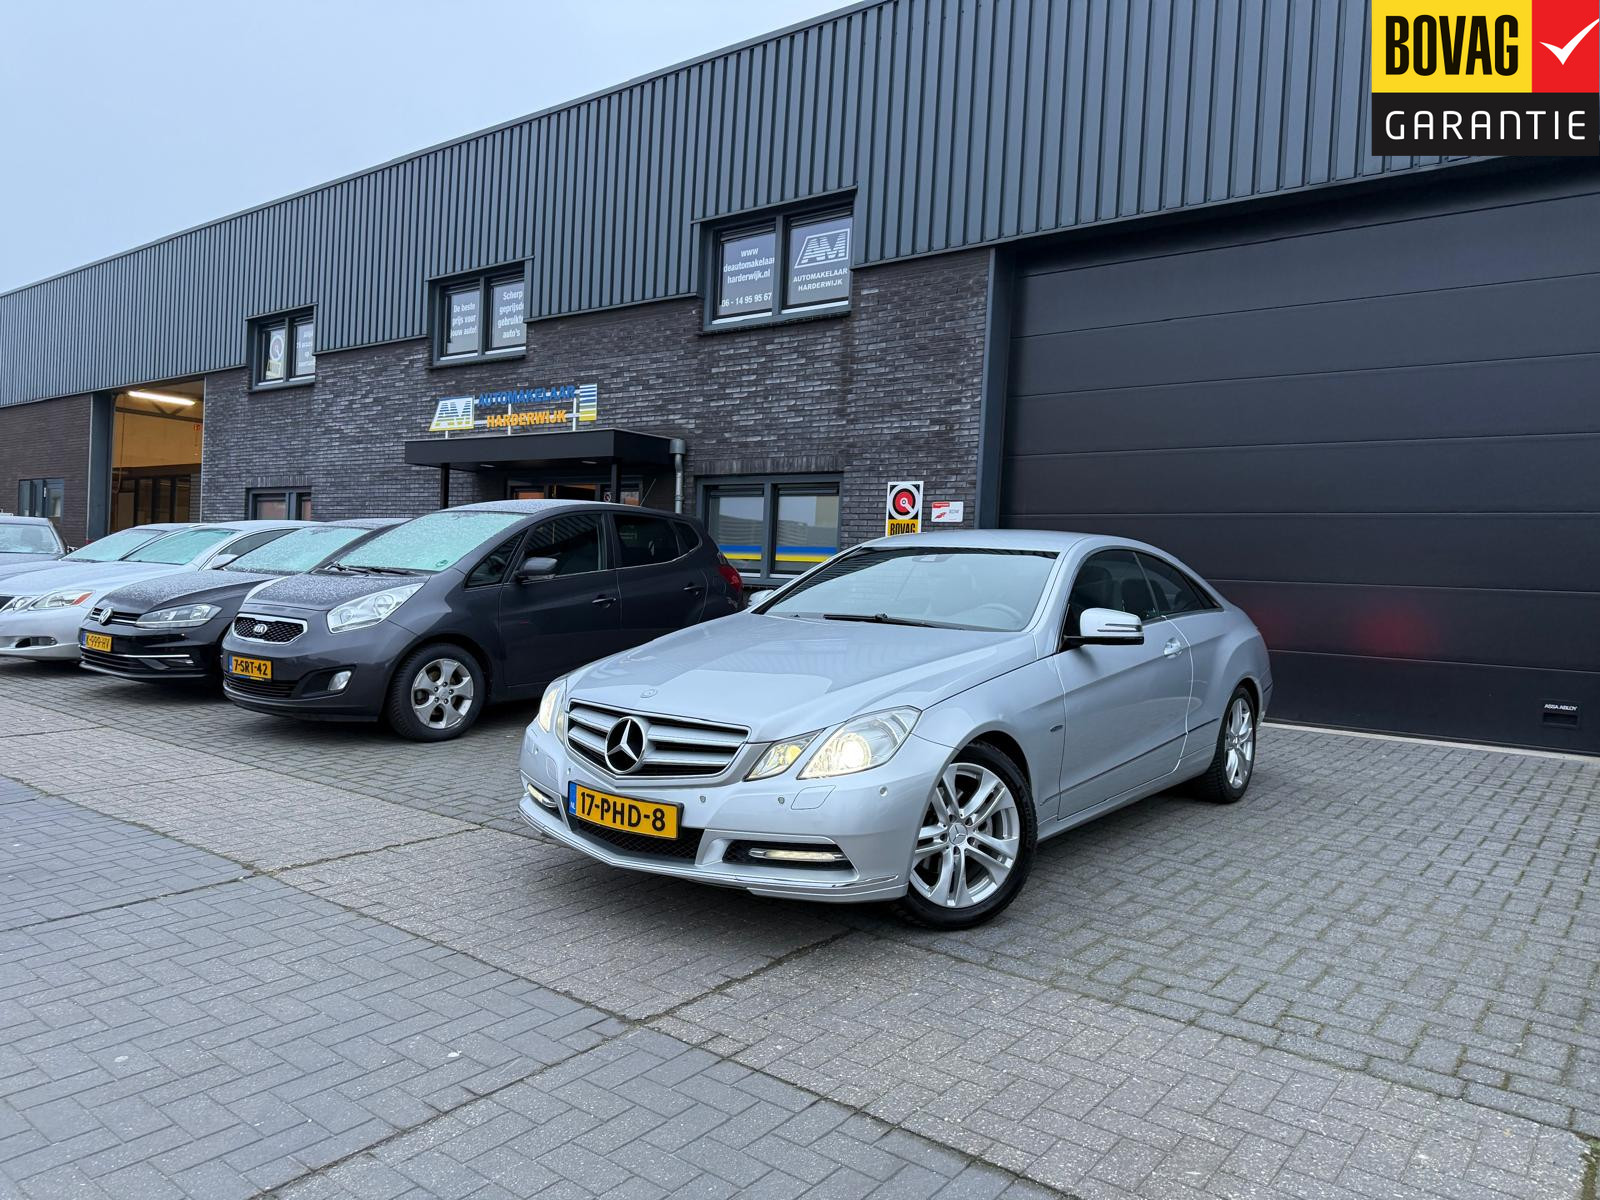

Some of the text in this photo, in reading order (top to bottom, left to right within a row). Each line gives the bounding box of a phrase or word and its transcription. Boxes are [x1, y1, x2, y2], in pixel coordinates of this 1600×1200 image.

[740, 248, 758, 258] www
[727, 268, 771, 284] harderwijk.nl
[793, 267, 848, 283] AUTOMAKELAAR
[798, 278, 843, 292] HARDERWIJK
[503, 290, 523, 301] Scherp
[721, 298, 730, 308] 06
[736, 296, 743, 305] 14
[745, 295, 753, 304] 95
[754, 293, 763, 303] 95
[763, 292, 772, 302] 67
[453, 302, 476, 313] De beste
[452, 315, 477, 327] prijs voor
[502, 329, 521, 339] auto's
[477, 385, 576, 408] AUTOMAKELAAR
[486, 409, 568, 428] HARDERWIJK
[889, 522, 916, 536] BOVAG
[233, 658, 268, 676] 7-SRT-42
[580, 791, 666, 832] 17-PHD-8
